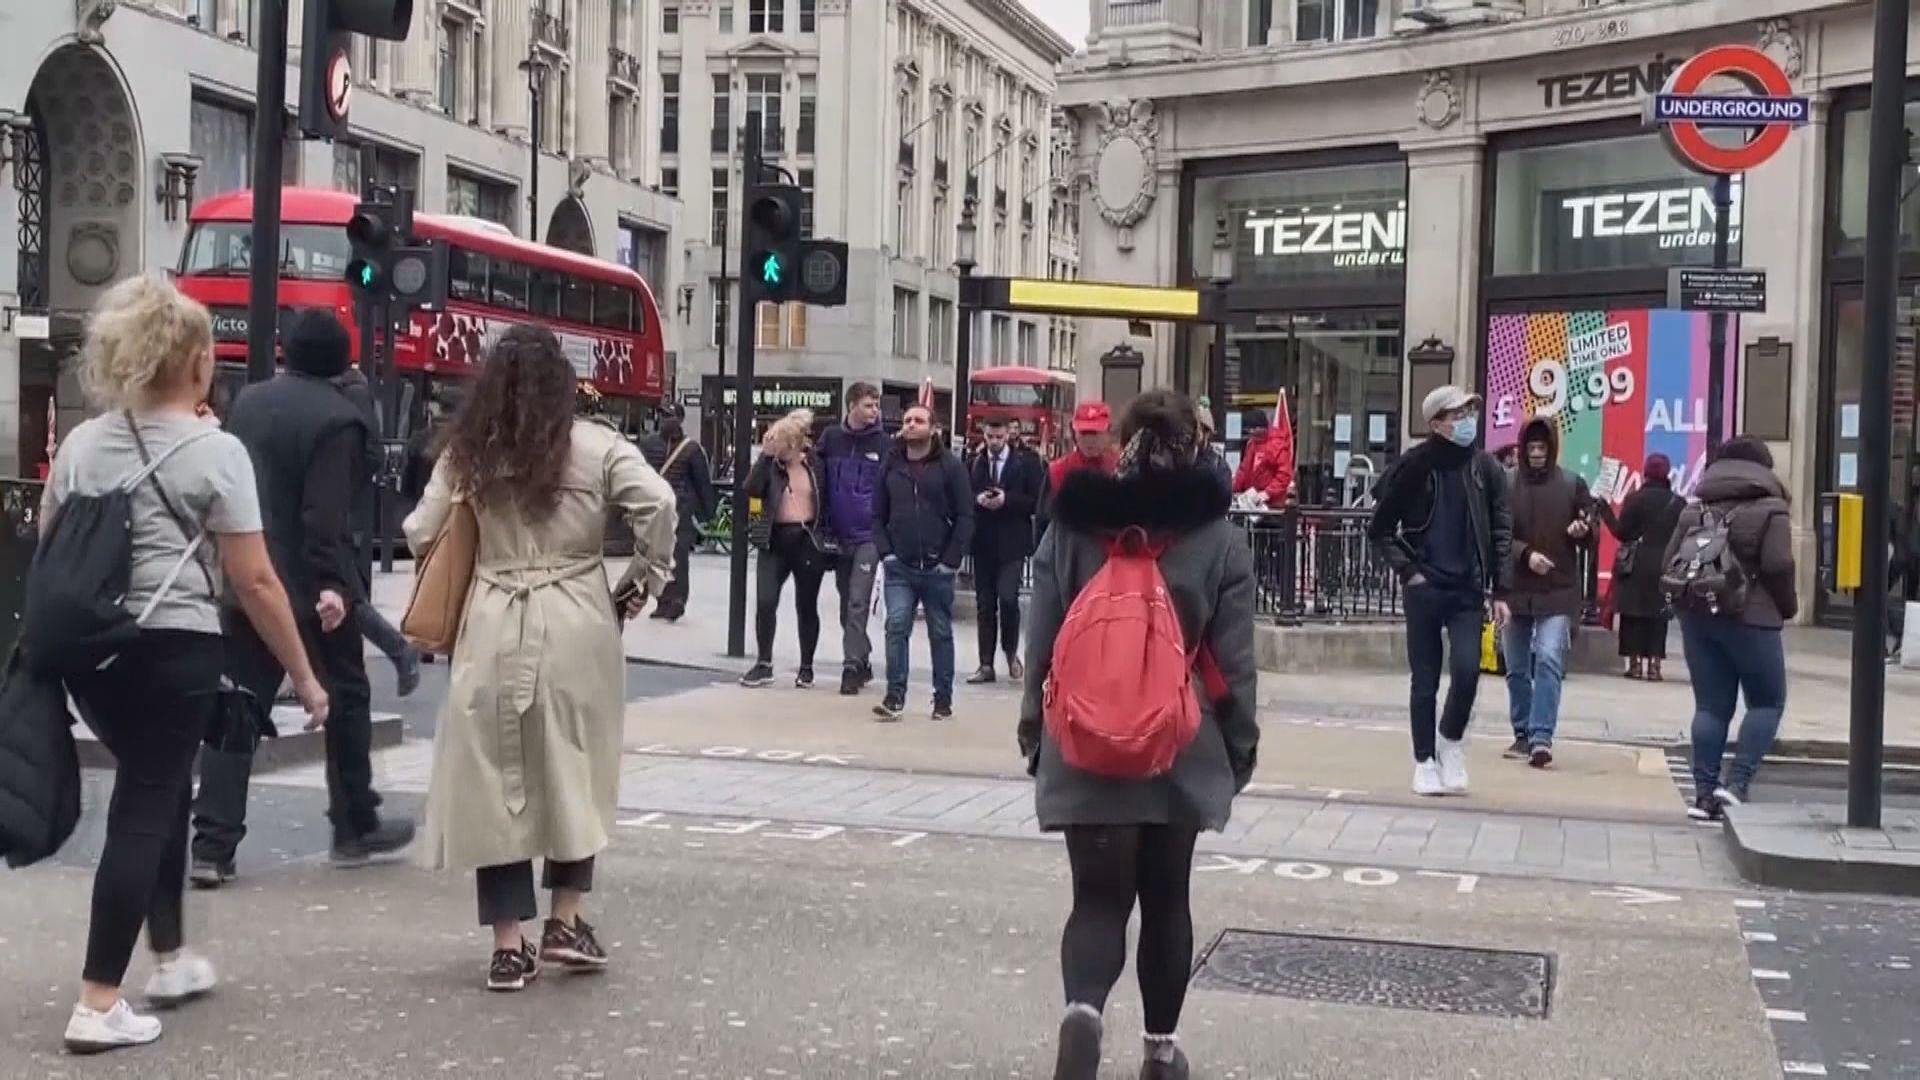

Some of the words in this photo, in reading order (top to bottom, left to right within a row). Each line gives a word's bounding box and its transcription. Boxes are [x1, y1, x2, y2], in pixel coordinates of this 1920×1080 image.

[1661, 99, 1803, 117] UNDERGROUND
[1570, 326, 1628, 353] LIMITED
[1572, 353, 1597, 367] TIME
[1600, 341, 1629, 358] ONLY
[1645, 398, 1708, 433] ALL
[633, 744, 866, 766] LOOK
[1194, 853, 1481, 894] LOOK
